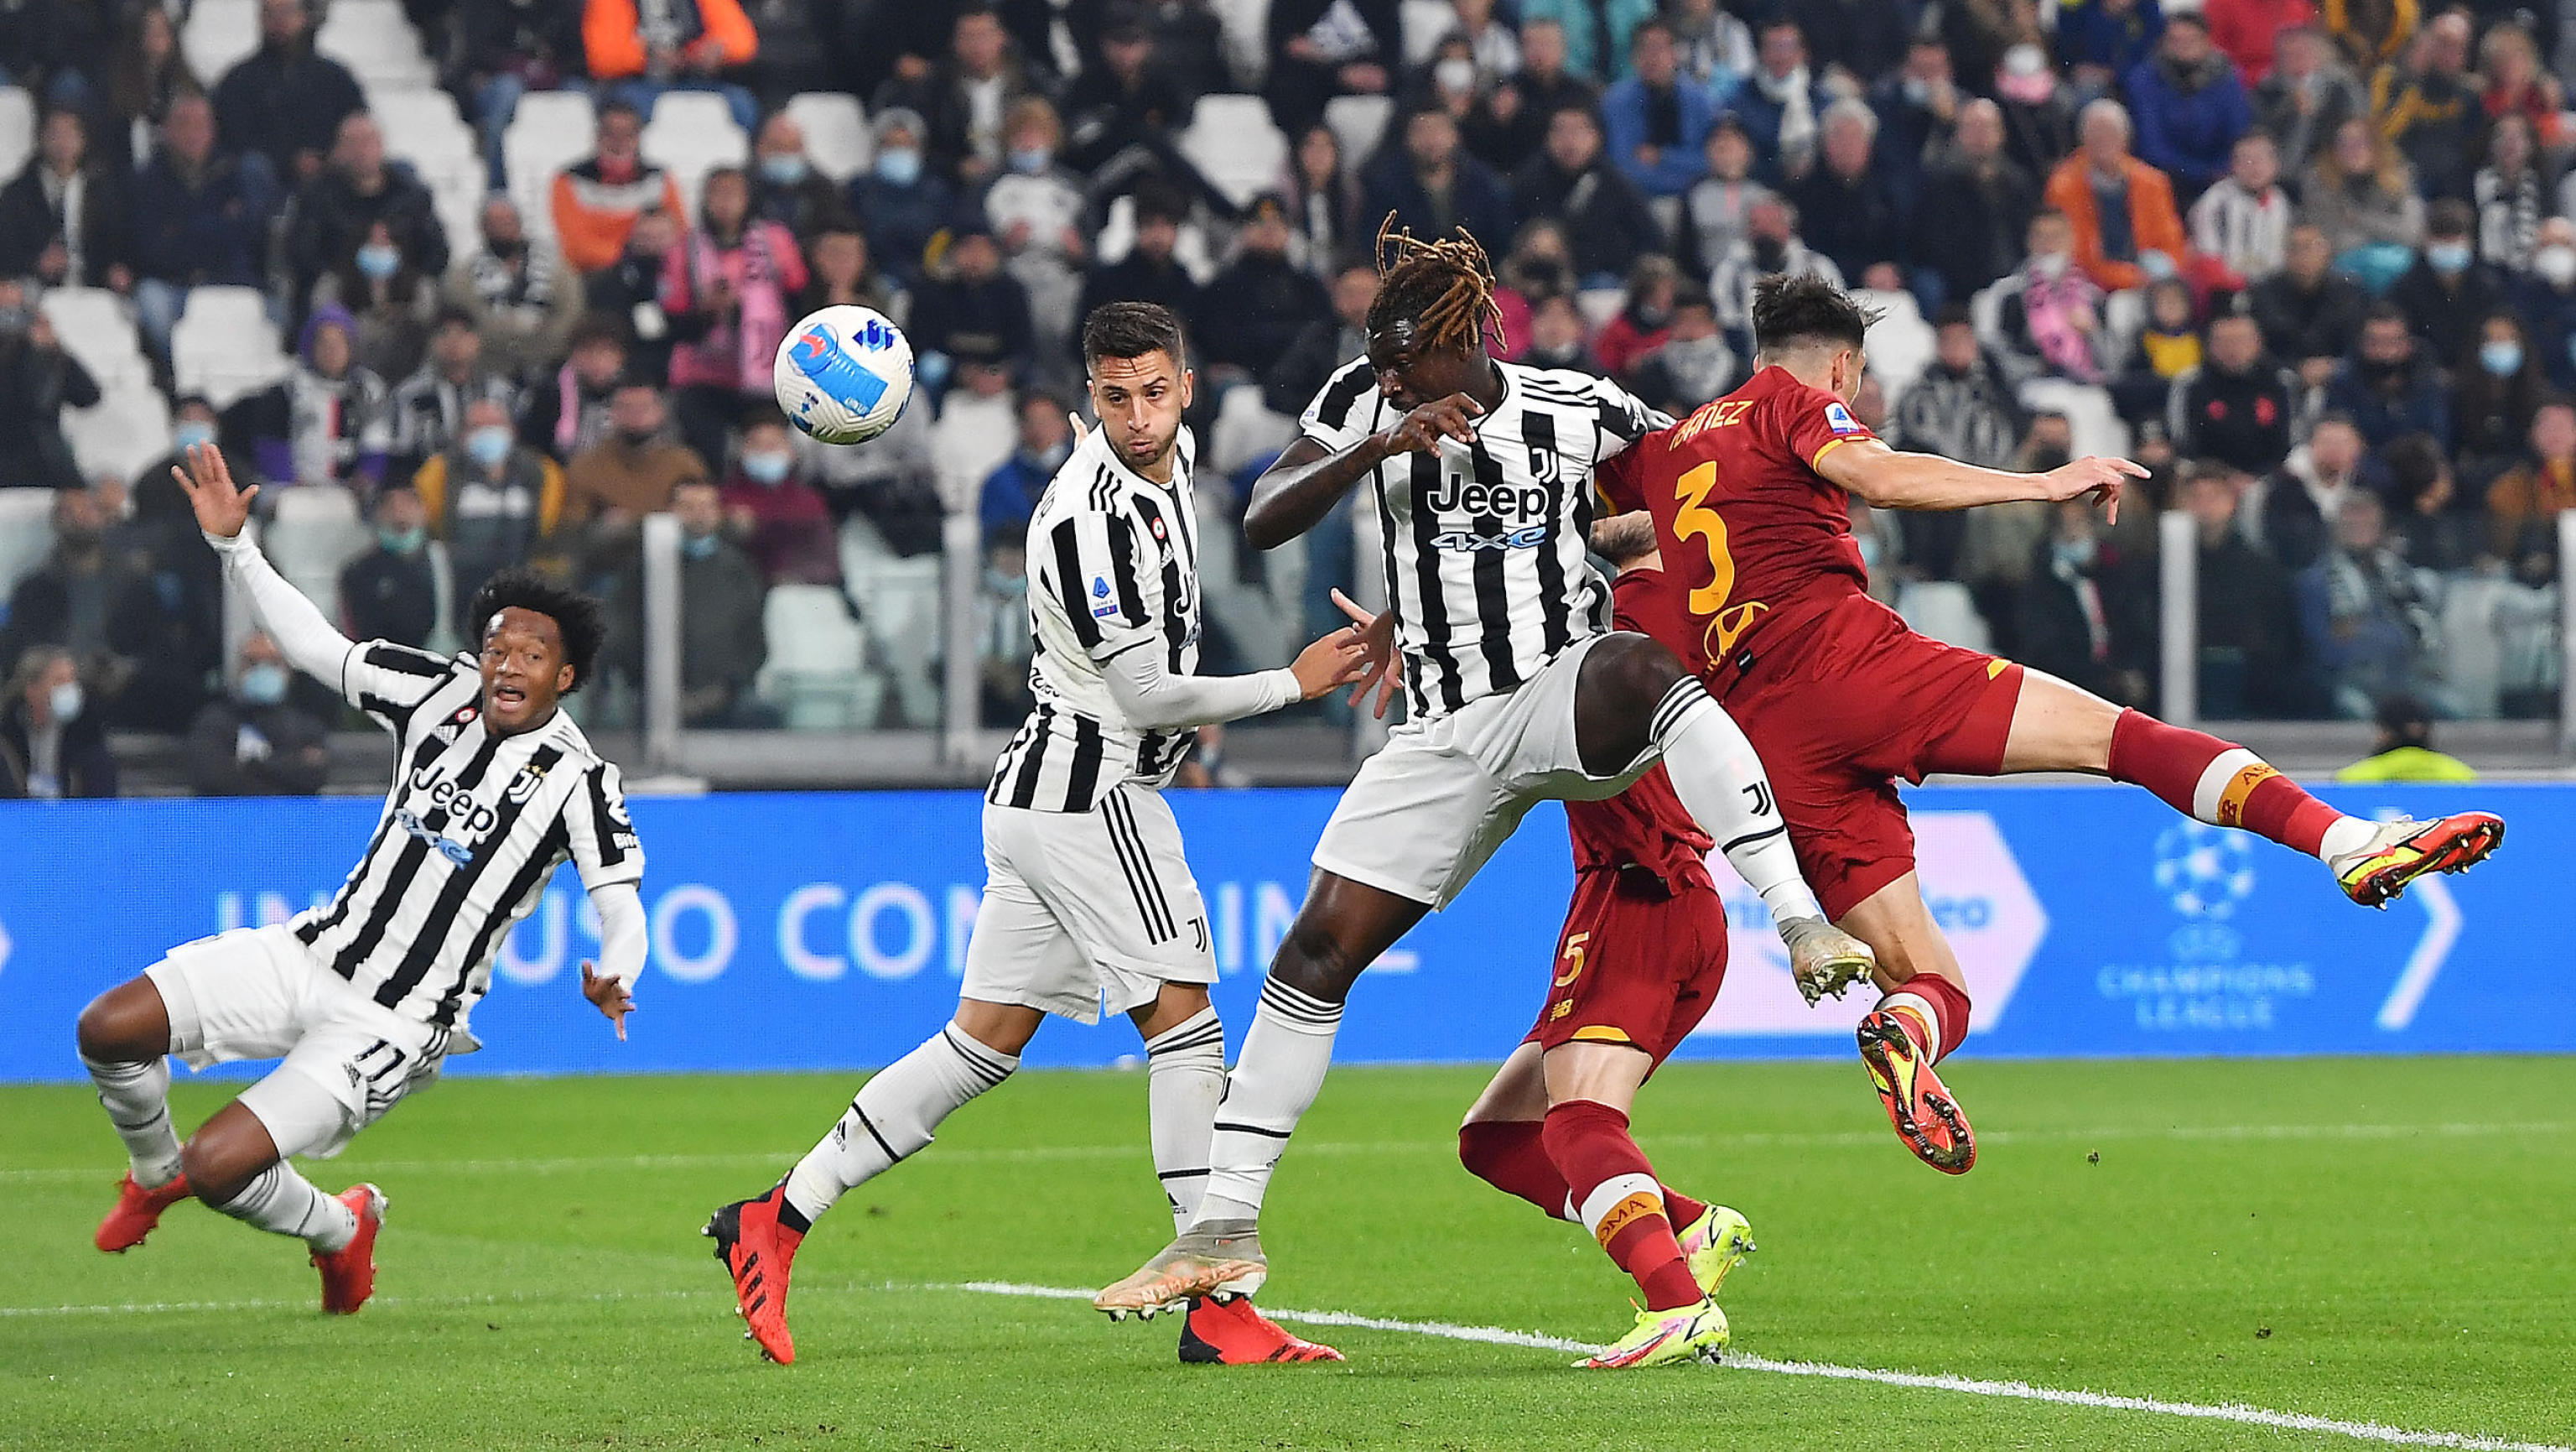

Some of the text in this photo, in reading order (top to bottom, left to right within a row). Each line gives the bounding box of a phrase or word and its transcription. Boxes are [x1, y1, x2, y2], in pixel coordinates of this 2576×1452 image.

[1428, 471, 1549, 526] Jeep
[1673, 461, 1735, 615] 3
[409, 766, 496, 832] Jeep
[1554, 931, 1590, 987] 5
[2097, 965, 2314, 996] CHAMPIONS
[2136, 998, 2273, 1027] LEAGUE
[1600, 1200, 1647, 1241] OMA
